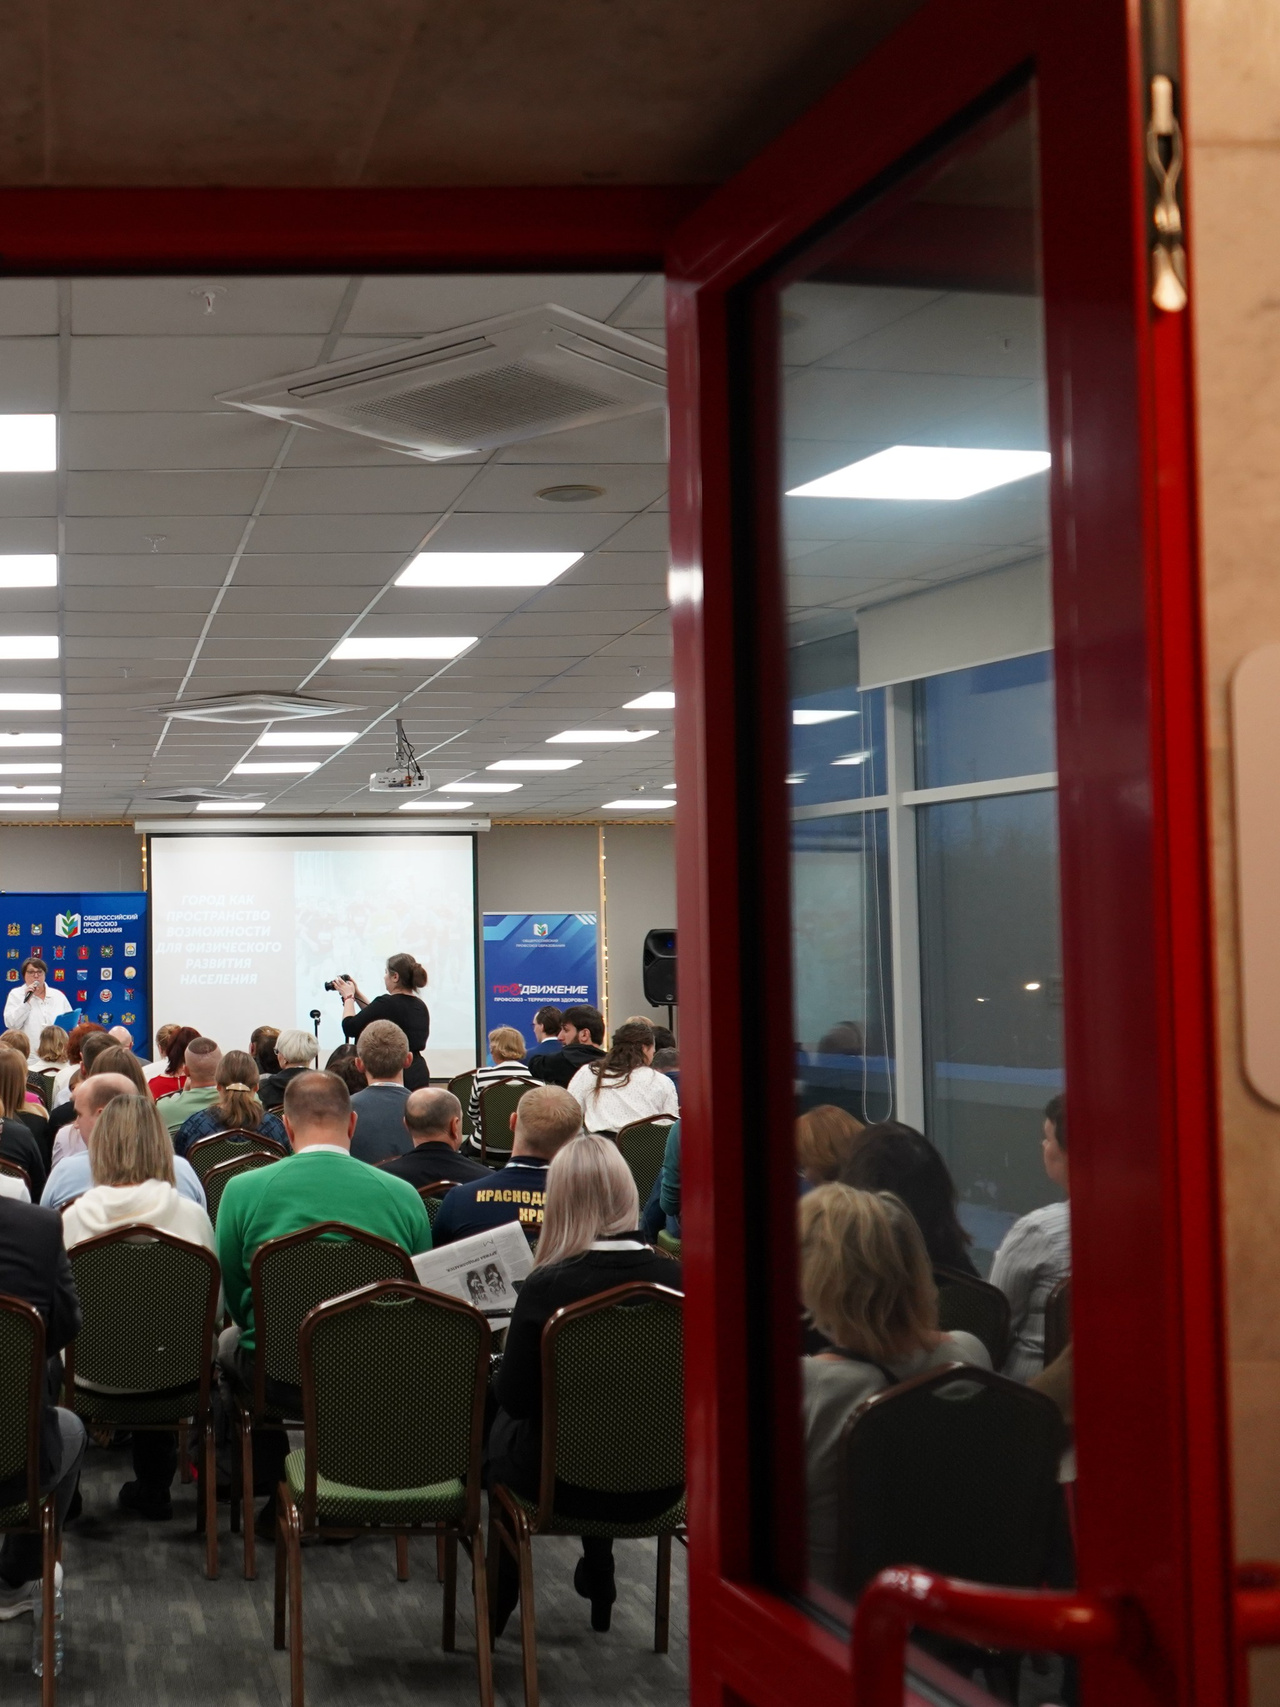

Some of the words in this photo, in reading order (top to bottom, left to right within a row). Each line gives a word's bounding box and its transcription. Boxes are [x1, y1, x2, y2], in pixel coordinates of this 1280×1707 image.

[180, 894, 225, 907] ГОРОД
[229, 894, 256, 905] КАК
[83, 913, 139, 921] ОБЩЕРОССИЙСКИЙ
[166, 910, 271, 922] ПРОСТРАНСТВО
[166, 926, 272, 938] ВОЗМОЖНОСТИ
[155, 942, 182, 954] ДЛЯ
[185, 941, 282, 953] ФИЗИЧЕСКОГО
[186, 958, 252, 969] РАЗВИТИЯ
[180, 973, 258, 985] НАСЕЛЕНИЯ
[519, 1207, 544, 1222] КРА
